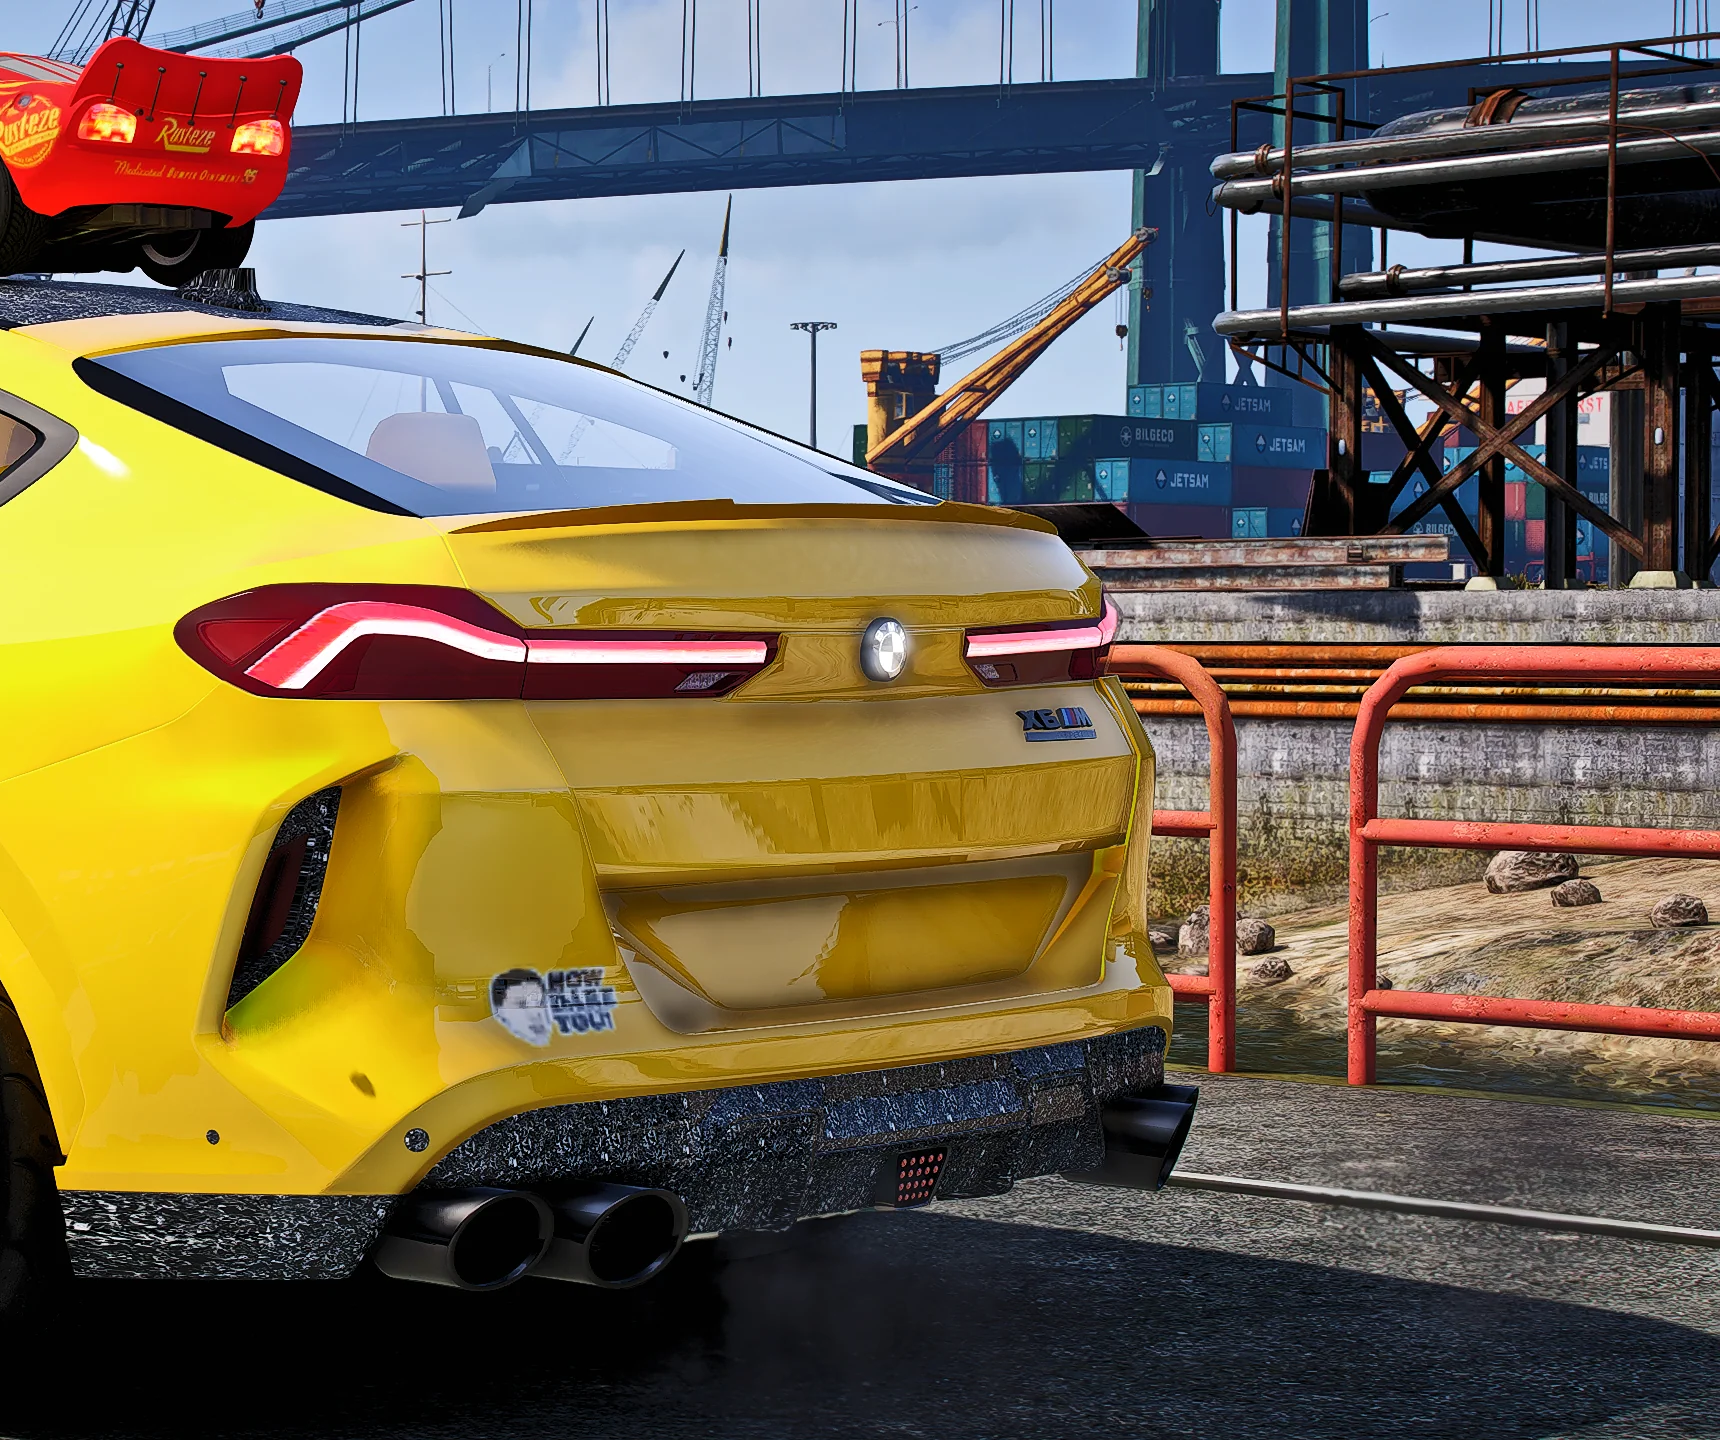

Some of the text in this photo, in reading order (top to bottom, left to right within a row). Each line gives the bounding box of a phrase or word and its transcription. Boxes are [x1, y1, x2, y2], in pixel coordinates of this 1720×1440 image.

[1234, 397, 1271, 413] JETSAM
[1135, 428, 1174, 443] BILGECO
[1269, 438, 1306, 453] JETSAM
[1588, 456, 1608, 470] JETS
[1170, 472, 1209, 488] JETSAM
